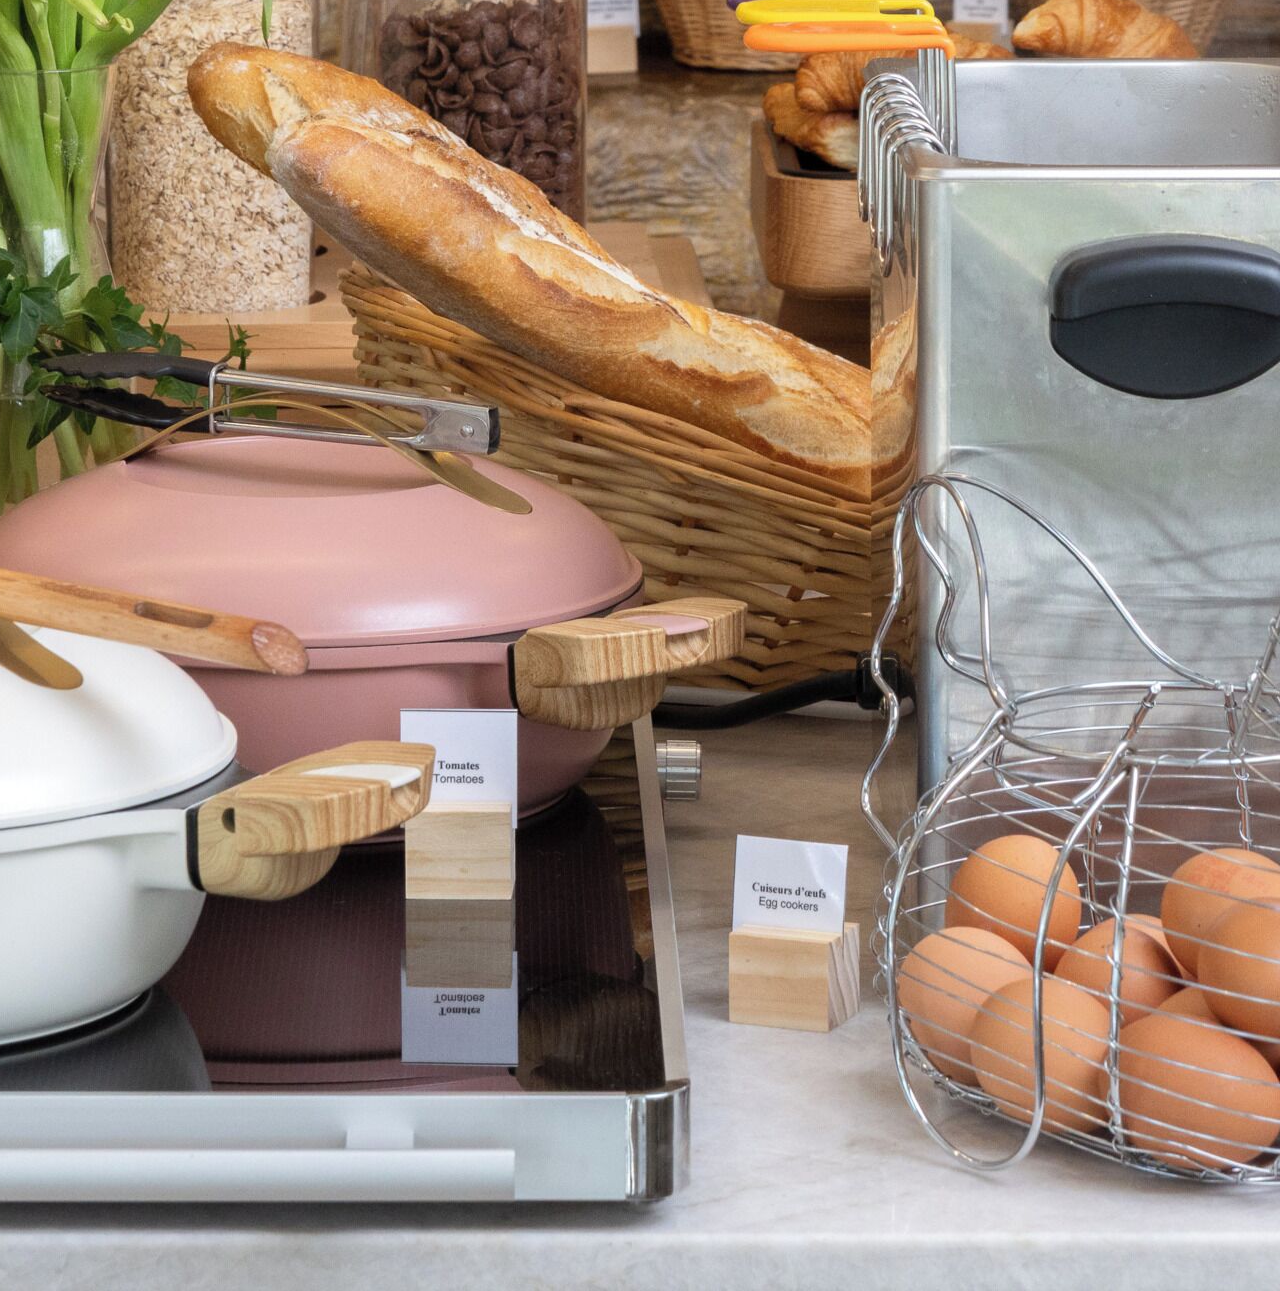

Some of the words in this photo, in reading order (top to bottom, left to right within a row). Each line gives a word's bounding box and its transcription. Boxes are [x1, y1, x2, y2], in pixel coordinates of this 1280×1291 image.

[437, 760, 480, 771] Tomates
[433, 773, 485, 785] Tomatoes
[751, 881, 793, 896] Cuiseurs
[758, 895, 778, 910] Egg
[780, 898, 819, 912] cookers
